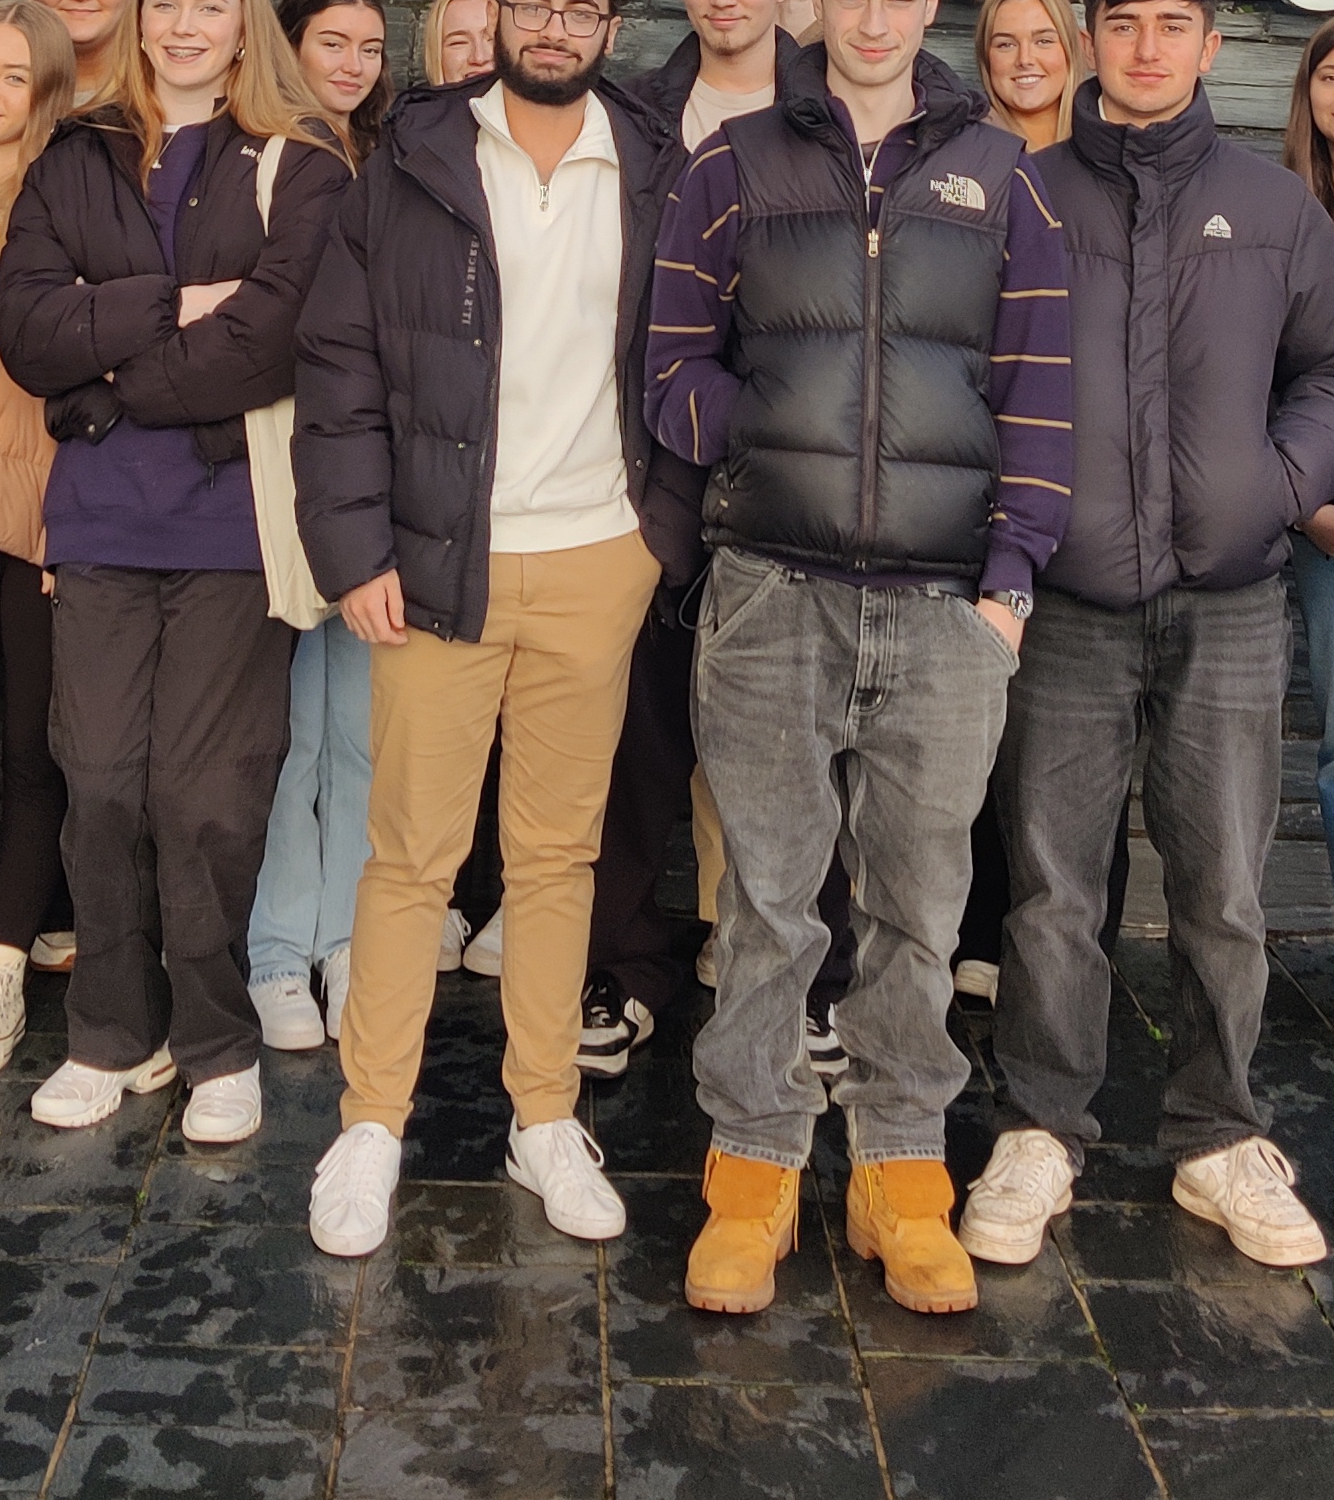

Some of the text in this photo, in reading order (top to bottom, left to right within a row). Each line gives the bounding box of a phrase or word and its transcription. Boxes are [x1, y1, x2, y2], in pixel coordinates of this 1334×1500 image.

[929, 179, 967, 197] NORTH
[946, 172, 968, 187] THE
[940, 190, 967, 207] FACE
